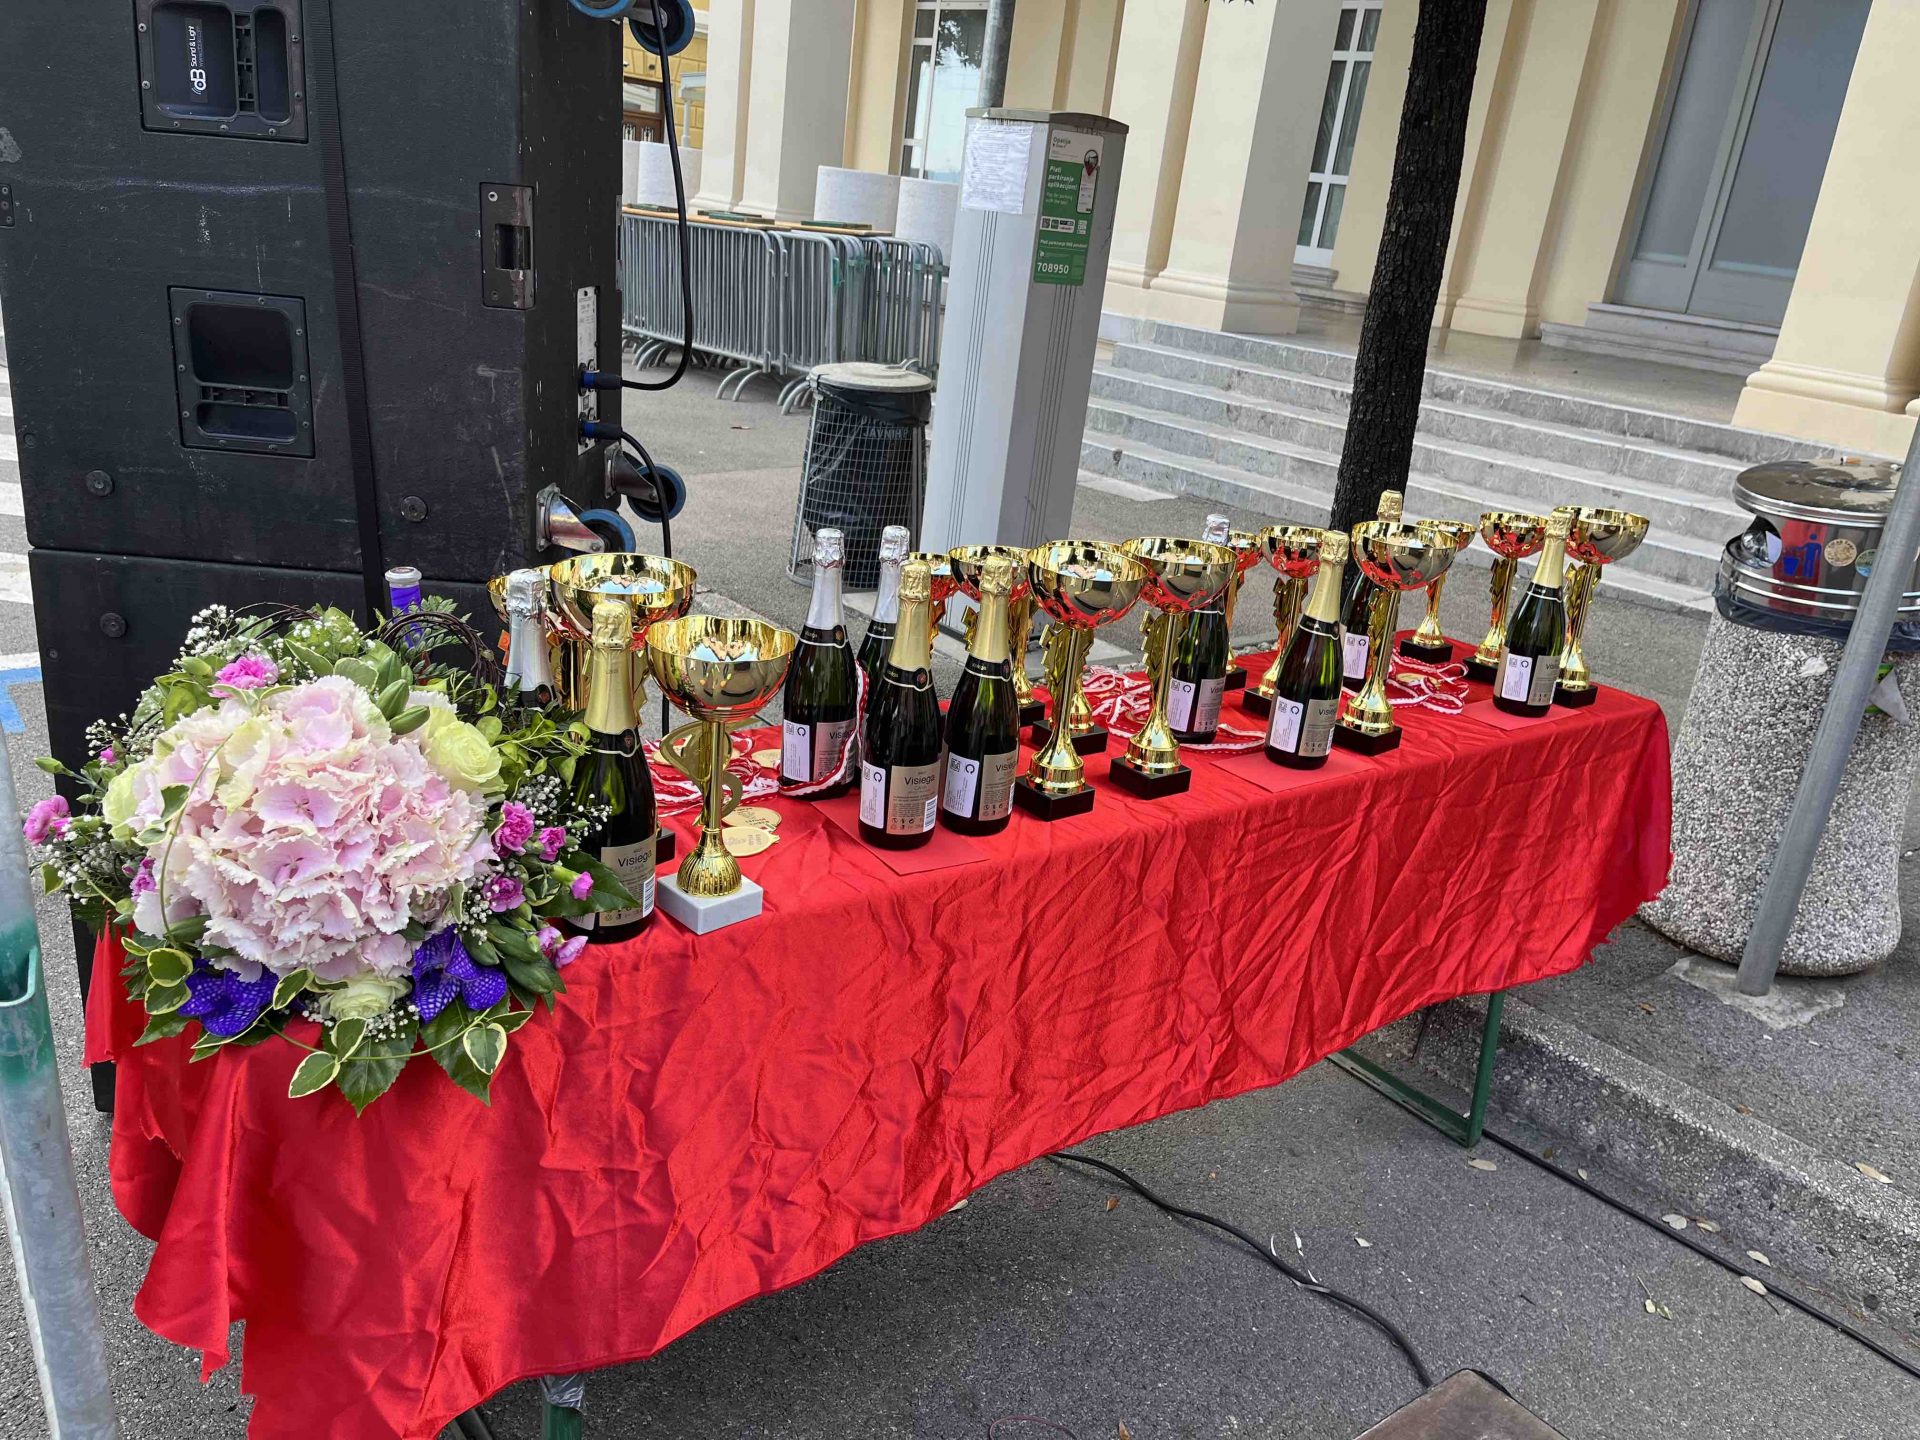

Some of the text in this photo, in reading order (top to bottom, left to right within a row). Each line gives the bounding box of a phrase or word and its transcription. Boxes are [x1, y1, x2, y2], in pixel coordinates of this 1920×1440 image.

[190, 47, 198, 67] Sound
[190, 68, 206, 91] dB
[1048, 174, 1075, 183] parkiranje
[1037, 262, 1069, 274] 708950
[617, 849, 652, 867] Visiega
